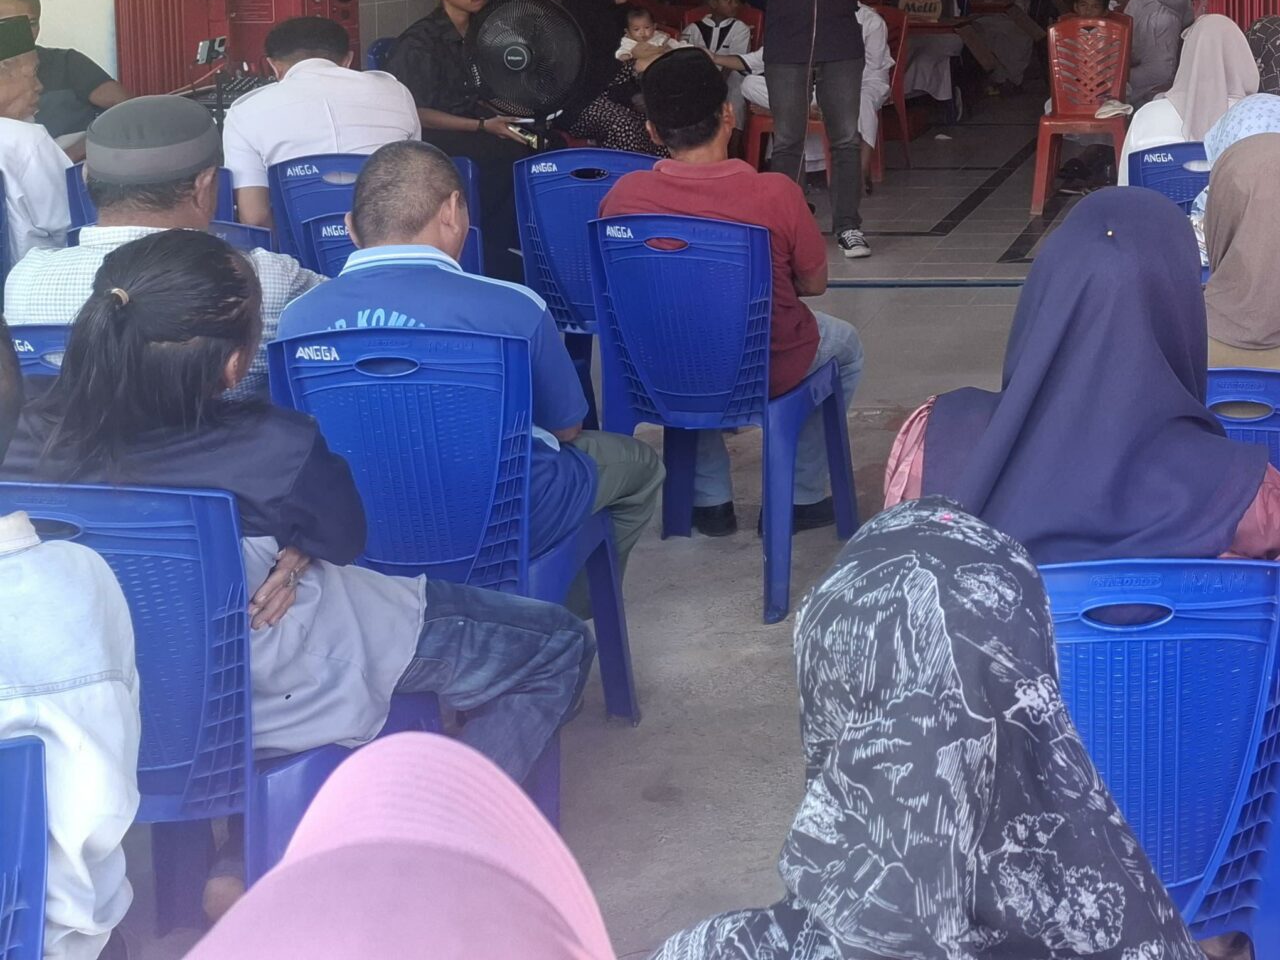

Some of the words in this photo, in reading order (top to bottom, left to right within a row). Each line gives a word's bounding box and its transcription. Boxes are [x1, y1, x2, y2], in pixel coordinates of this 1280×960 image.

[1143, 152, 1174, 163] ANGGA
[286, 164, 320, 177] ANGGA
[531, 162, 558, 174] ANGGA
[606, 224, 634, 239] ANGGA
[295, 345, 340, 361] ANGGA
